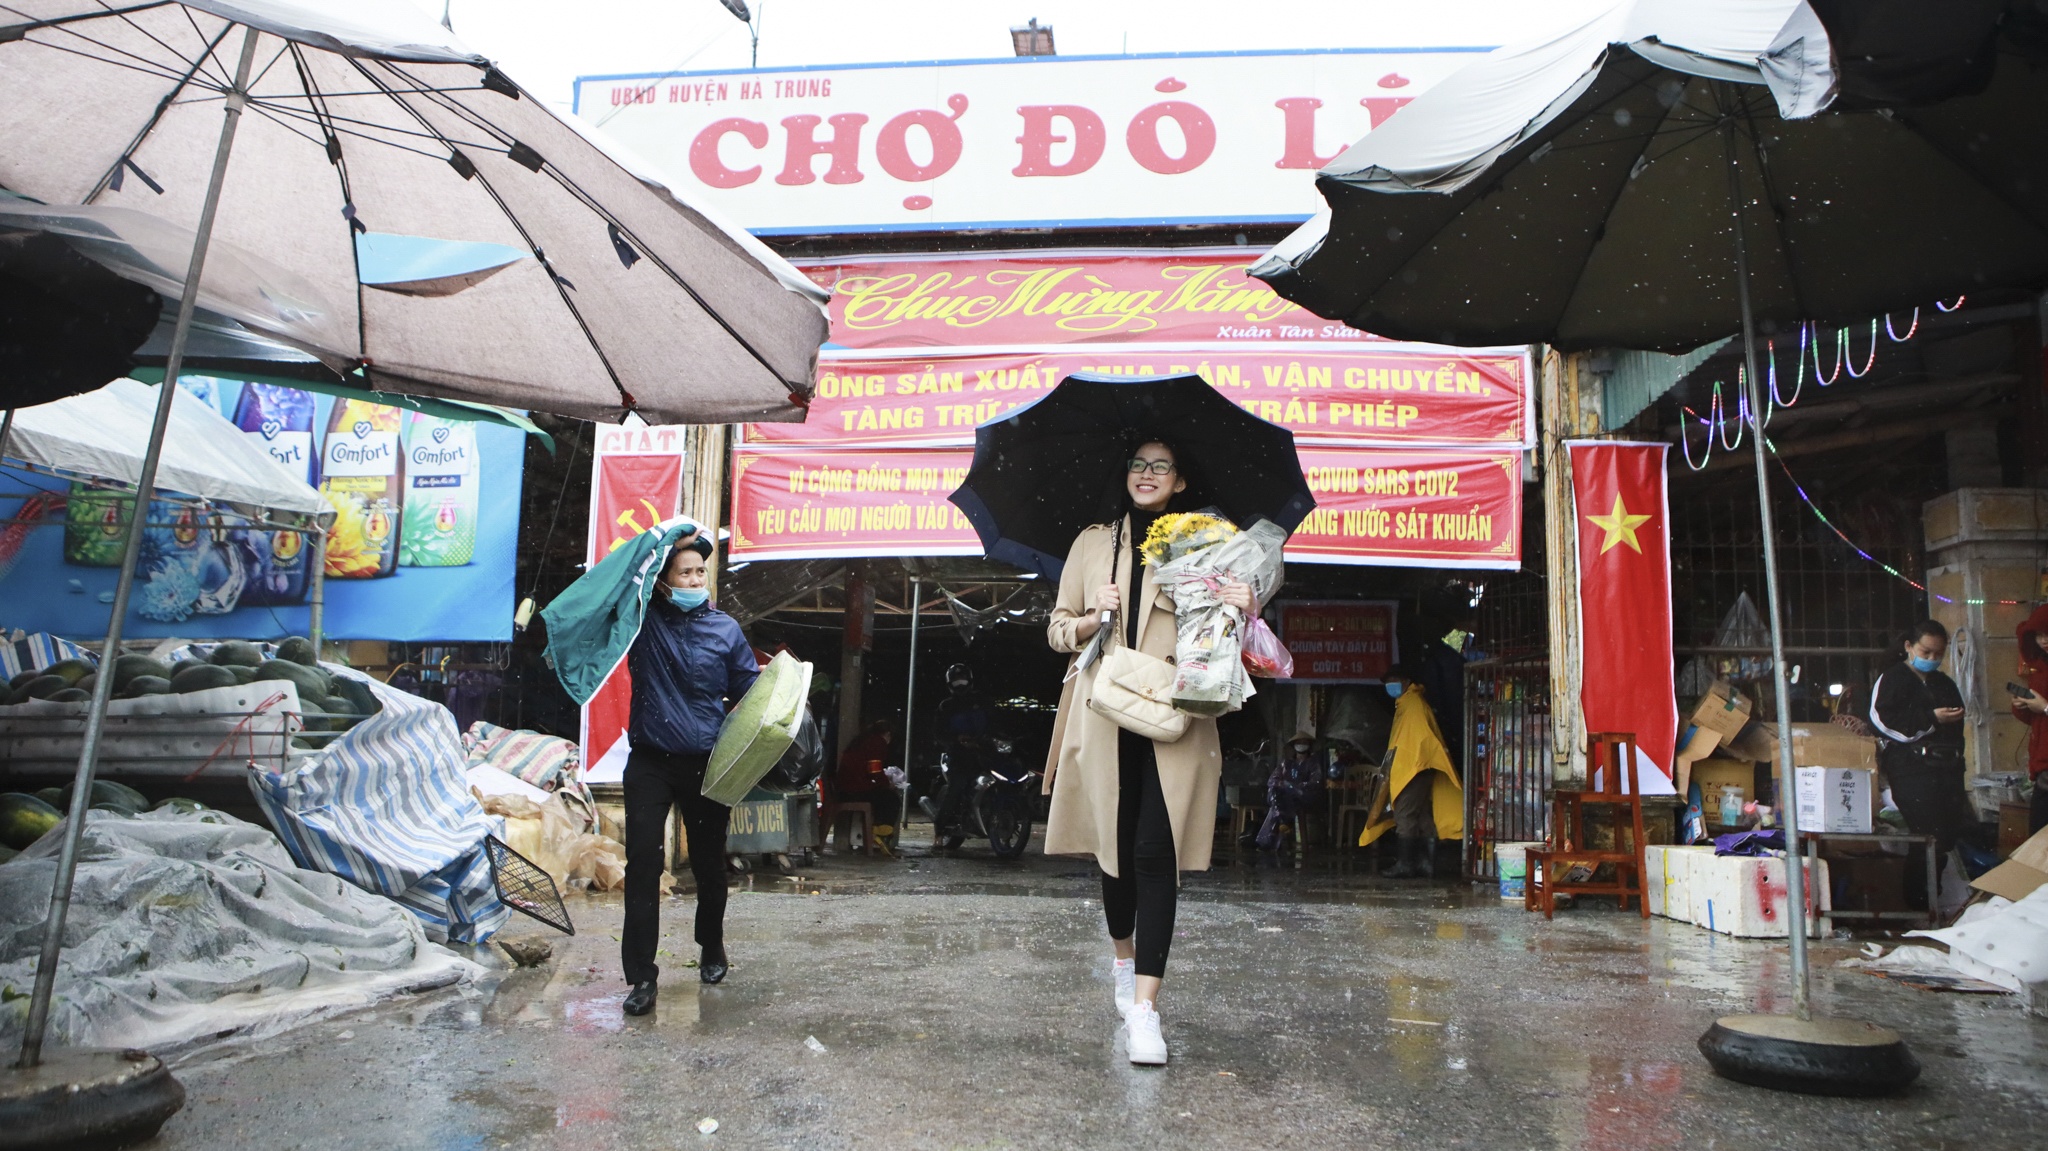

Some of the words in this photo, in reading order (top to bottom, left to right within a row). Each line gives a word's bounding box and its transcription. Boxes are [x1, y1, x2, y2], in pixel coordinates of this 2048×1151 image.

[611, 87, 656, 106] UBND
[668, 79, 728, 107] HUYỆN
[740, 76, 763, 100] HÀ
[774, 78, 832, 98] TRUNG
[689, 93, 969, 211] CHỢ
[835, 271, 1000, 330] Chúc
[986, 267, 1161, 333] Mừng
[1216, 325, 1273, 339] Xuân
[1279, 325, 1316, 339] Tân
[815, 371, 885, 399] ÔNG
[895, 364, 964, 396] SẢN
[973, 359, 1059, 391] XUẤT
[1262, 362, 1331, 393] VẬN
[1344, 361, 1492, 397] CHUYỂN,
[840, 405, 924, 431] TÀNG
[1240, 396, 1317, 424] TRÁI
[1329, 400, 1420, 429] PHÉP
[331, 441, 389, 465] Comfort
[412, 445, 466, 466] Comfort
[789, 465, 803, 494] VÌ
[808, 464, 852, 498] CỘNG
[856, 461, 901, 492] ĐỒNG
[905, 467, 938, 496] MỌI
[942, 467, 971, 490] NG
[1308, 466, 1359, 494] COVID
[1364, 467, 1409, 496] SARS
[1415, 470, 1459, 498] COV2
[757, 505, 786, 535] YÊU
[789, 499, 822, 534] CẦU
[825, 506, 857, 537] MỌI
[860, 500, 911, 533] NGƯỜI
[916, 500, 949, 531] VÀO
[1343, 503, 1390, 538] NƯỚC
[1395, 506, 1428, 540] SÁT
[1432, 504, 1492, 542] KHUẨN
[1289, 641, 1323, 654] CHUNG
[1326, 641, 1345, 654] TAY
